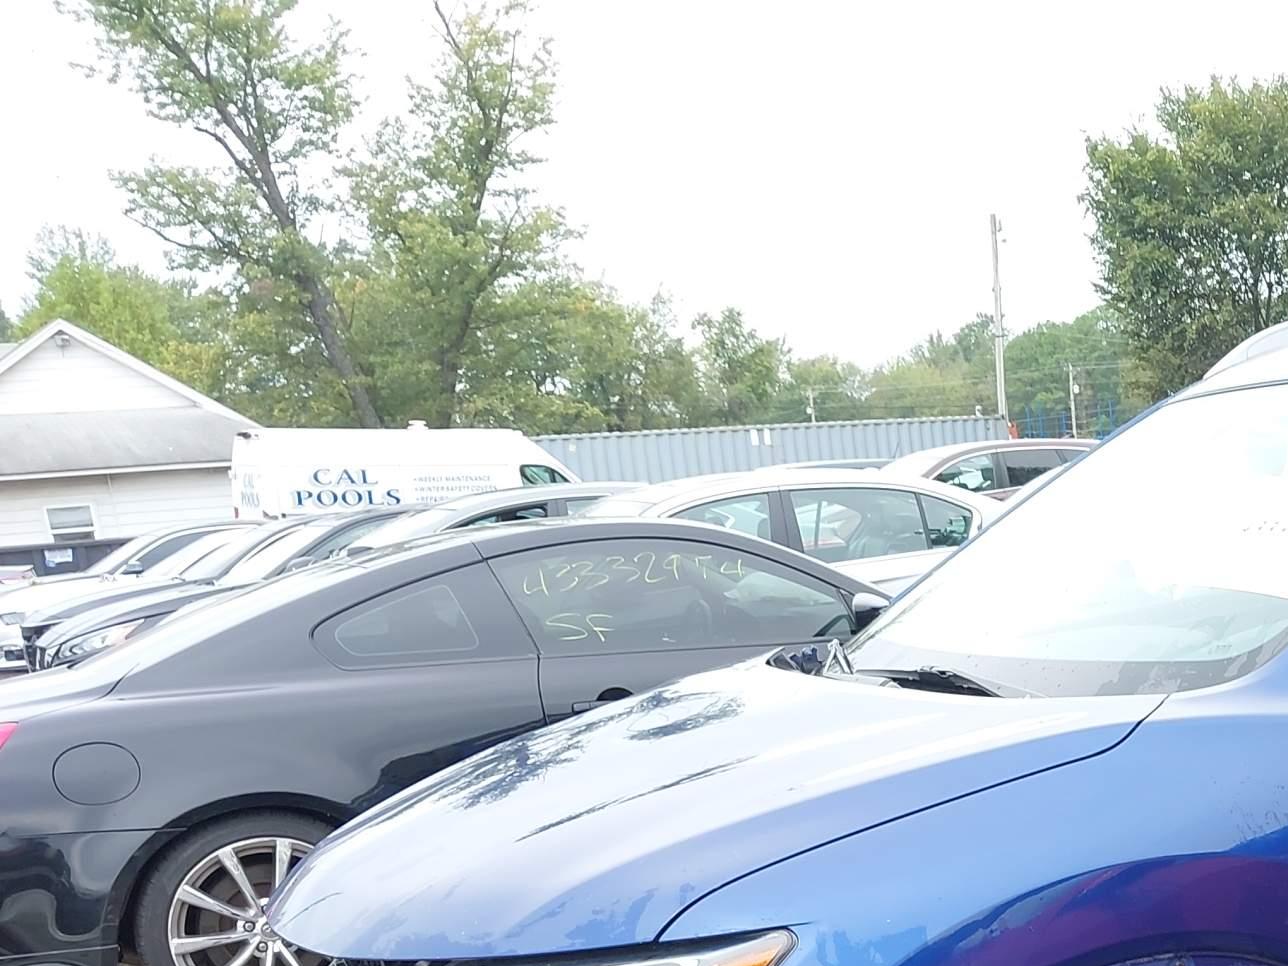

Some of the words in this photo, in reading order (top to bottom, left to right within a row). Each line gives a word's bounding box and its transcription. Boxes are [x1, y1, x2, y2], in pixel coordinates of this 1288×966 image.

[311, 468, 379, 486] CAL
[295, 488, 402, 506] POOLS
[545, 612, 615, 643] SF
